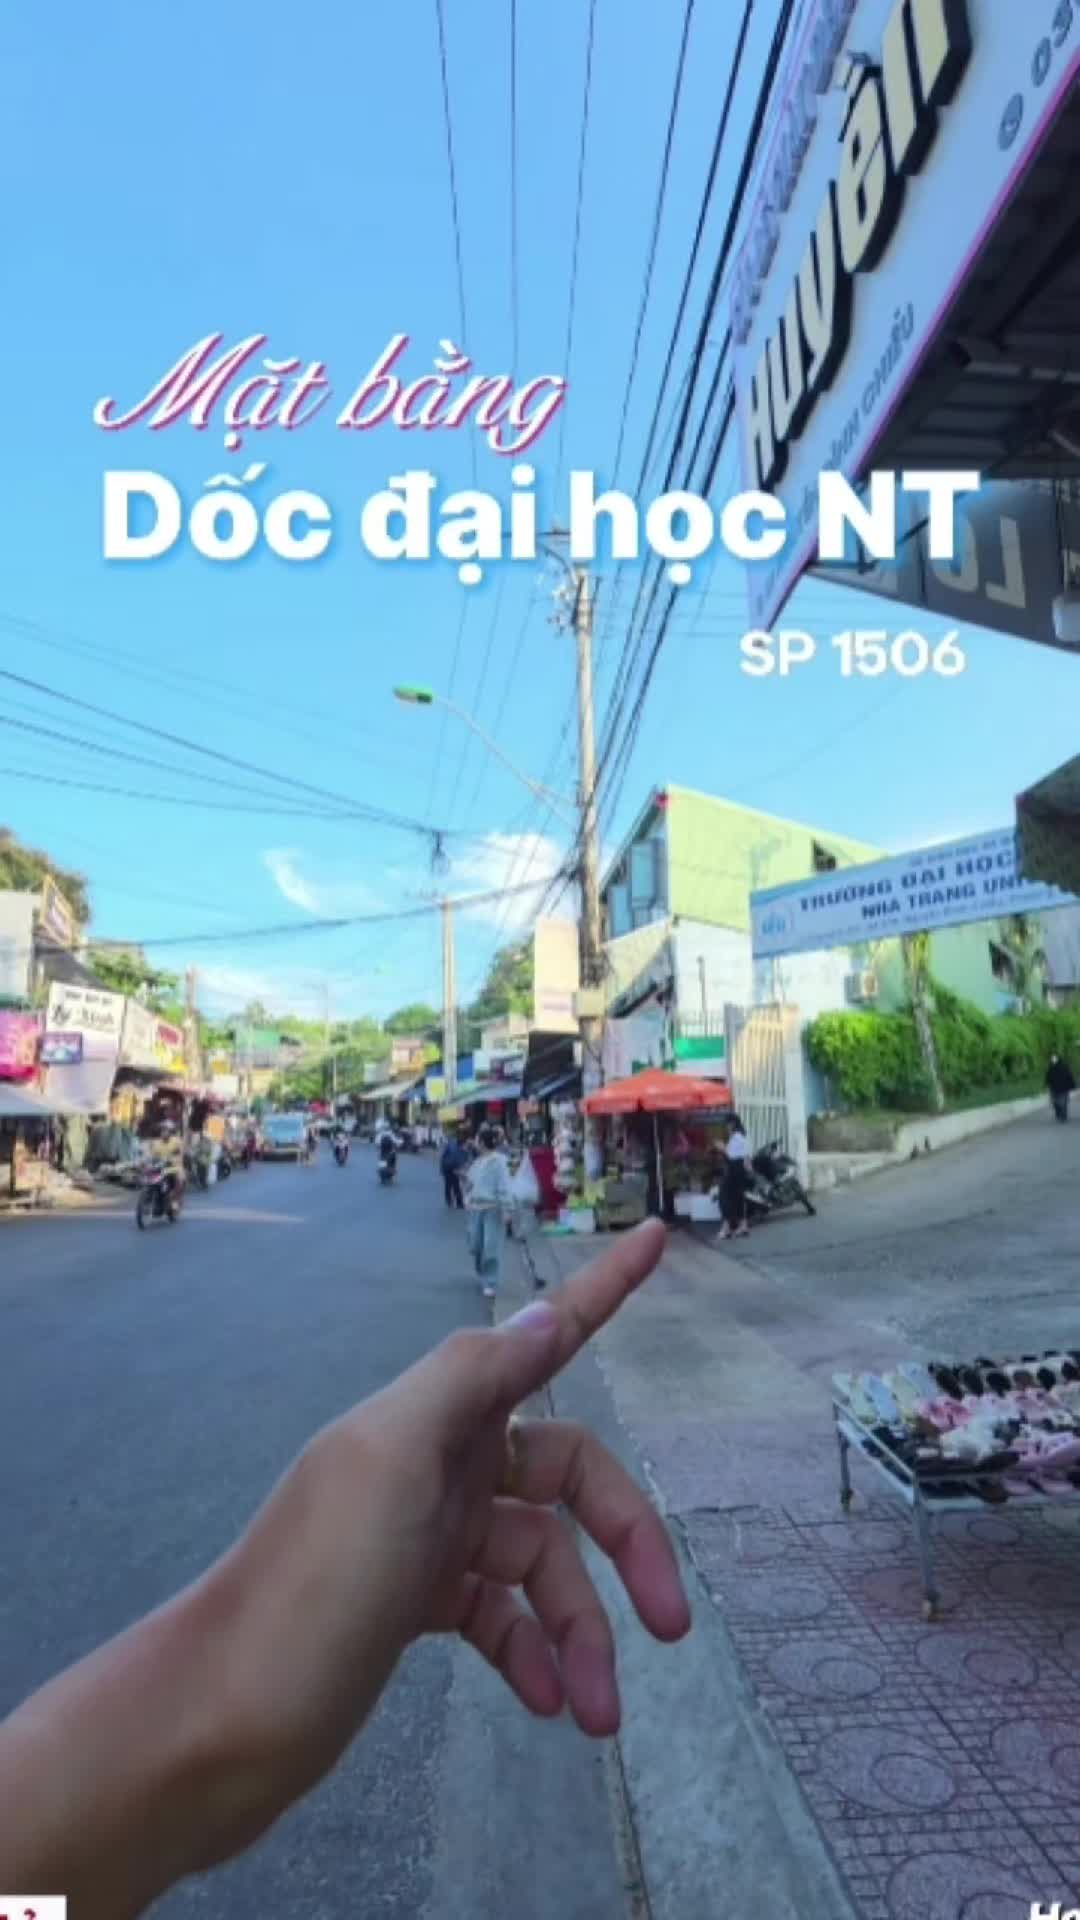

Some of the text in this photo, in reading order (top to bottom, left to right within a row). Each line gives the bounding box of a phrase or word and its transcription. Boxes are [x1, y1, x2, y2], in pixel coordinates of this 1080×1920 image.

[861, 899, 901, 921] NHA
[908, 885, 977, 911] TRANG
[983, 872, 1024, 895] UNI
